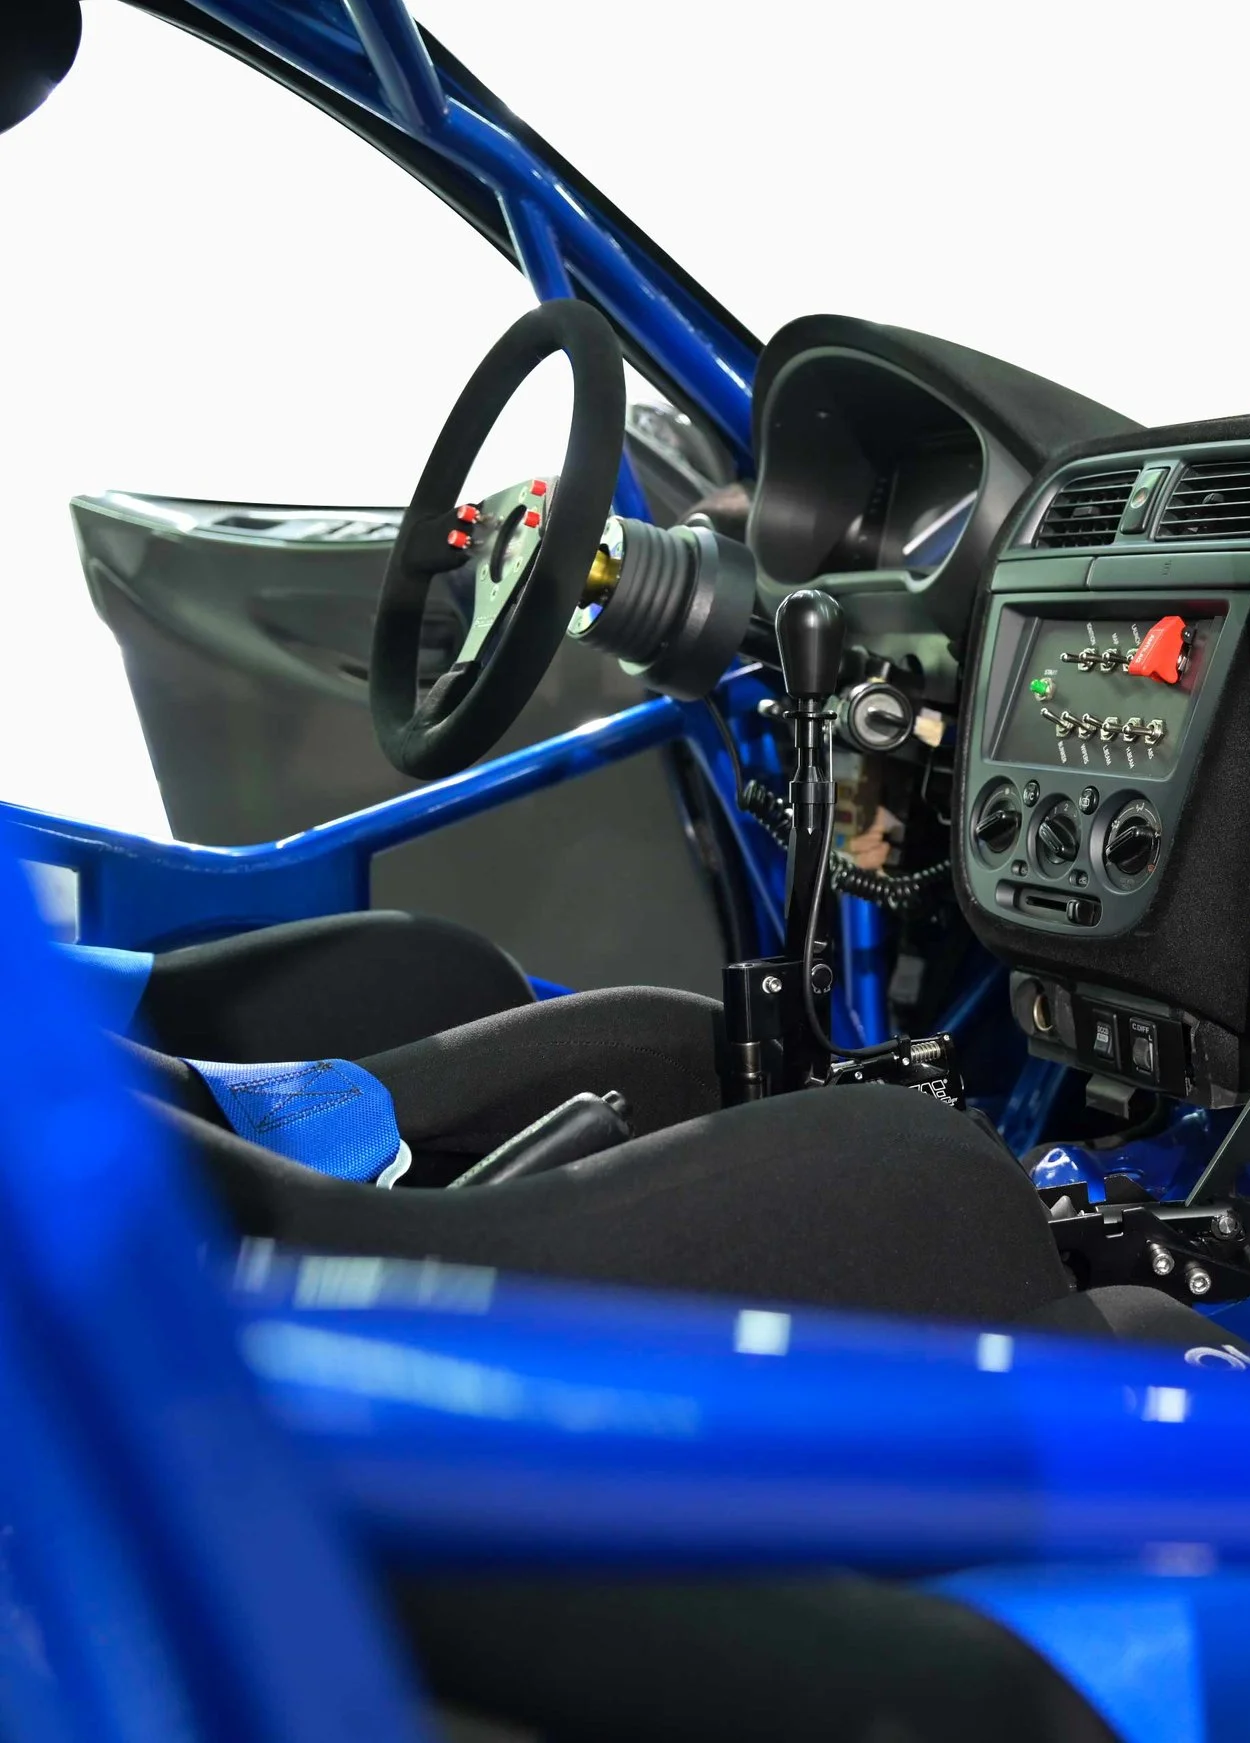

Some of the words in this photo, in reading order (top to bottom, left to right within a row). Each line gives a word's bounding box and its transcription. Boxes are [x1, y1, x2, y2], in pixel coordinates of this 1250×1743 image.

[1131, 623, 1141, 646] LAUNCH
[1080, 743, 1089, 765] WIPERS
[1063, 803, 1069, 812] 2
